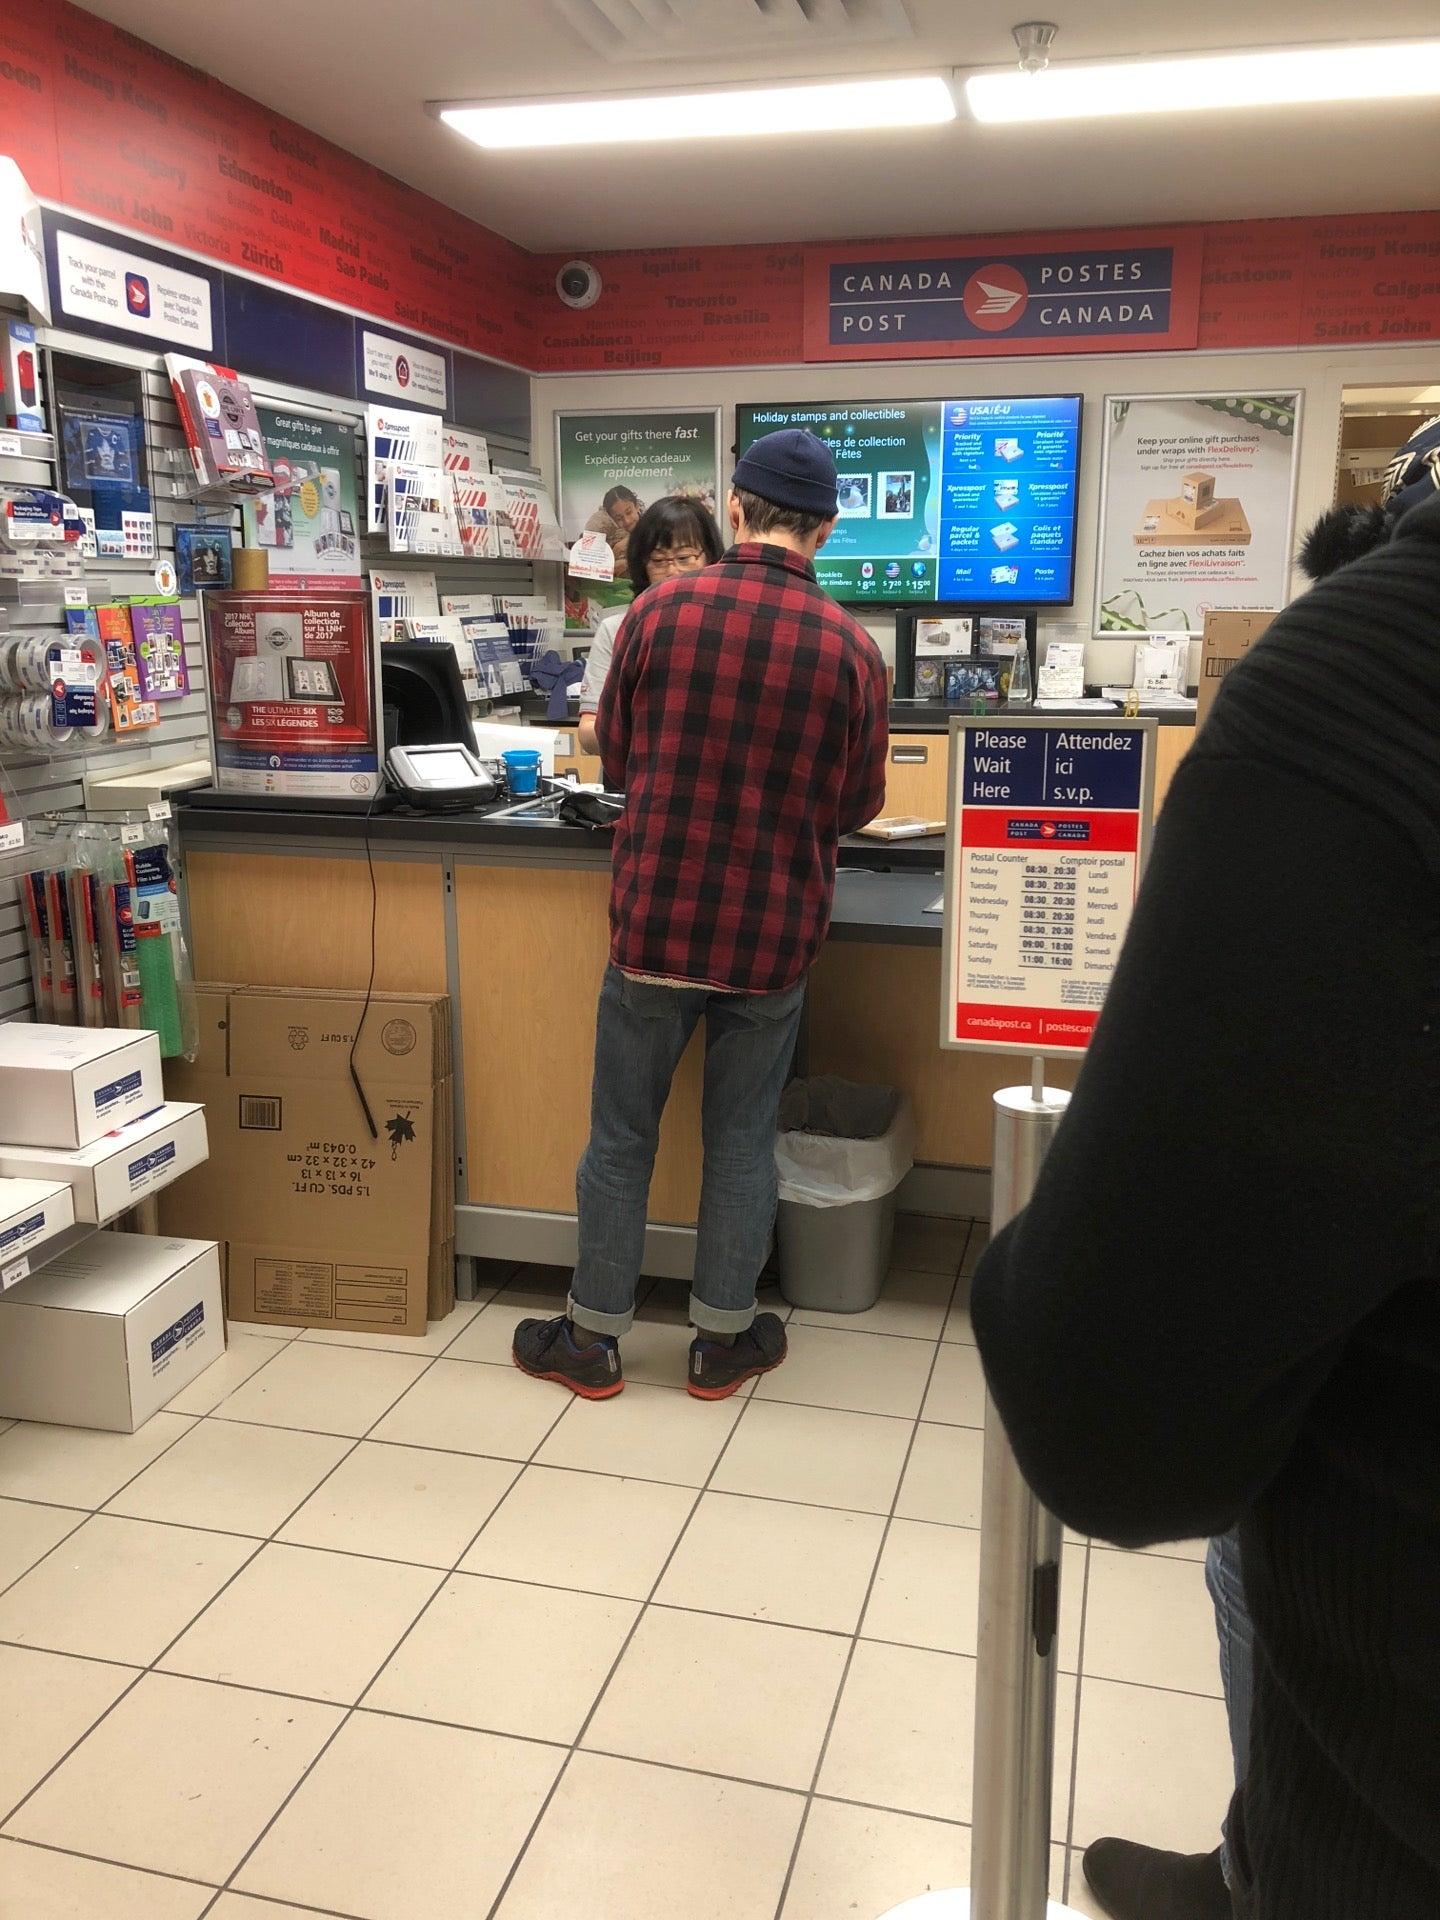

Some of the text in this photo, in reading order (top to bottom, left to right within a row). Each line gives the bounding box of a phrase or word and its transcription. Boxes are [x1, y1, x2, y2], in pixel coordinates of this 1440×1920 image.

[218, 154, 293, 205] Edmonton
[184, 222, 231, 256] Victoria
[319, 226, 360, 258] Madrid
[241, 239, 285, 274] Zürich
[336, 255, 390, 291] Sao Paulo
[843, 262, 1143, 293] CANADA POSTES
[664, 294, 738, 310] Toronto
[843, 303, 1155, 333] POST CANADA
[1313, 317, 1432, 338] Saint John
[542, 333, 634, 350] Casablanca
[603, 348, 663, 366] Beijing
[753, 407, 906, 426] Holiday stamps and collectibles
[275, 416, 323, 435] Great gifts to give
[575, 431, 593, 442] Get
[595, 432, 617, 444] your
[620, 429, 643, 443] gifts
[645, 428, 672, 440] there
[844, 436, 856, 448] de
[858, 435, 906, 448] collection
[953, 433, 982, 442] Priority
[1036, 431, 1065, 440] Priorité
[1137, 434, 1260, 447] Keep your online gift purchases
[267, 436, 301, 452] magnifiques
[322, 445, 327, 454] à
[1137, 446, 1160, 456] under
[1161, 447, 1186, 456] wraps
[1187, 446, 1206, 455] with
[584, 453, 692, 466] Expédiez vos cadeaux
[835, 448, 862, 460] Fêtes
[603, 465, 674, 481] rapidement
[946, 484, 987, 493] Xpresspost
[1028, 483, 1069, 492] Xpresspost
[951, 525, 980, 534] Regular
[1032, 524, 1062, 532] Colis et
[949, 533, 974, 541] parcel
[1029, 538, 1063, 546] standard
[1031, 532, 1062, 541] paquets
[950, 539, 980, 548] packets
[1139, 549, 1245, 558] Cachez bien vos achats faits
[1149, 559, 1168, 570] ligne
[955, 568, 972, 576] Mail
[1034, 568, 1055, 576] Poste
[829, 579, 853, 587] timbres
[224, 612, 239, 621] 2017
[304, 609, 341, 619] Album de
[224, 619, 255, 629] Collector's
[304, 617, 340, 626] collection
[234, 627, 255, 635] Album
[304, 625, 316, 633] sur
[316, 624, 325, 633] la
[304, 631, 334, 641] de 2017
[252, 706, 318, 716] THE ULTIMATE SIX
[251, 717, 319, 729] LES SIX LÉGENDES
[974, 731, 1132, 751] Please Attendez
[973, 756, 1074, 775] Wait ici
[973, 781, 1094, 805] Here s.v.p.
[970, 852, 1029, 864] Postal Counter
[1059, 855, 1126, 868] Comptoir postal
[970, 865, 1109, 880] Monday 08:30 20:30 Lundi
[970, 880, 1109, 895] Tuesday 08:30 20:30 Mardi
[969, 895, 1119, 911] Wednesday 08:30 20:30 Mercredi
[969, 910, 1105, 926] Thursday 08:30 20:30 Jeudi
[968, 925, 1117, 941] Friday 08:30 20:30 Vendredi
[967, 939, 1111, 956] Saturday 09:00 18:00 Samedi
[967, 954, 993, 966] Sunday
[1022, 955, 1044, 964] 11:00
[1050, 956, 1073, 966] 16:00
[966, 1016, 1032, 1030] canadapost.ca
[323, 1142, 356, 1154] 0.043
[286, 1153, 303, 1163] cm
[306, 1155, 321, 1166] 32
[334, 1157, 349, 1168] 32
[361, 1158, 376, 1170] 42
[301, 1169, 313, 1180] 13
[325, 1171, 337, 1181] 13
[350, 1171, 362, 1182] 16
[292, 1181, 371, 1197] 1.5 PDS. CU FT.
